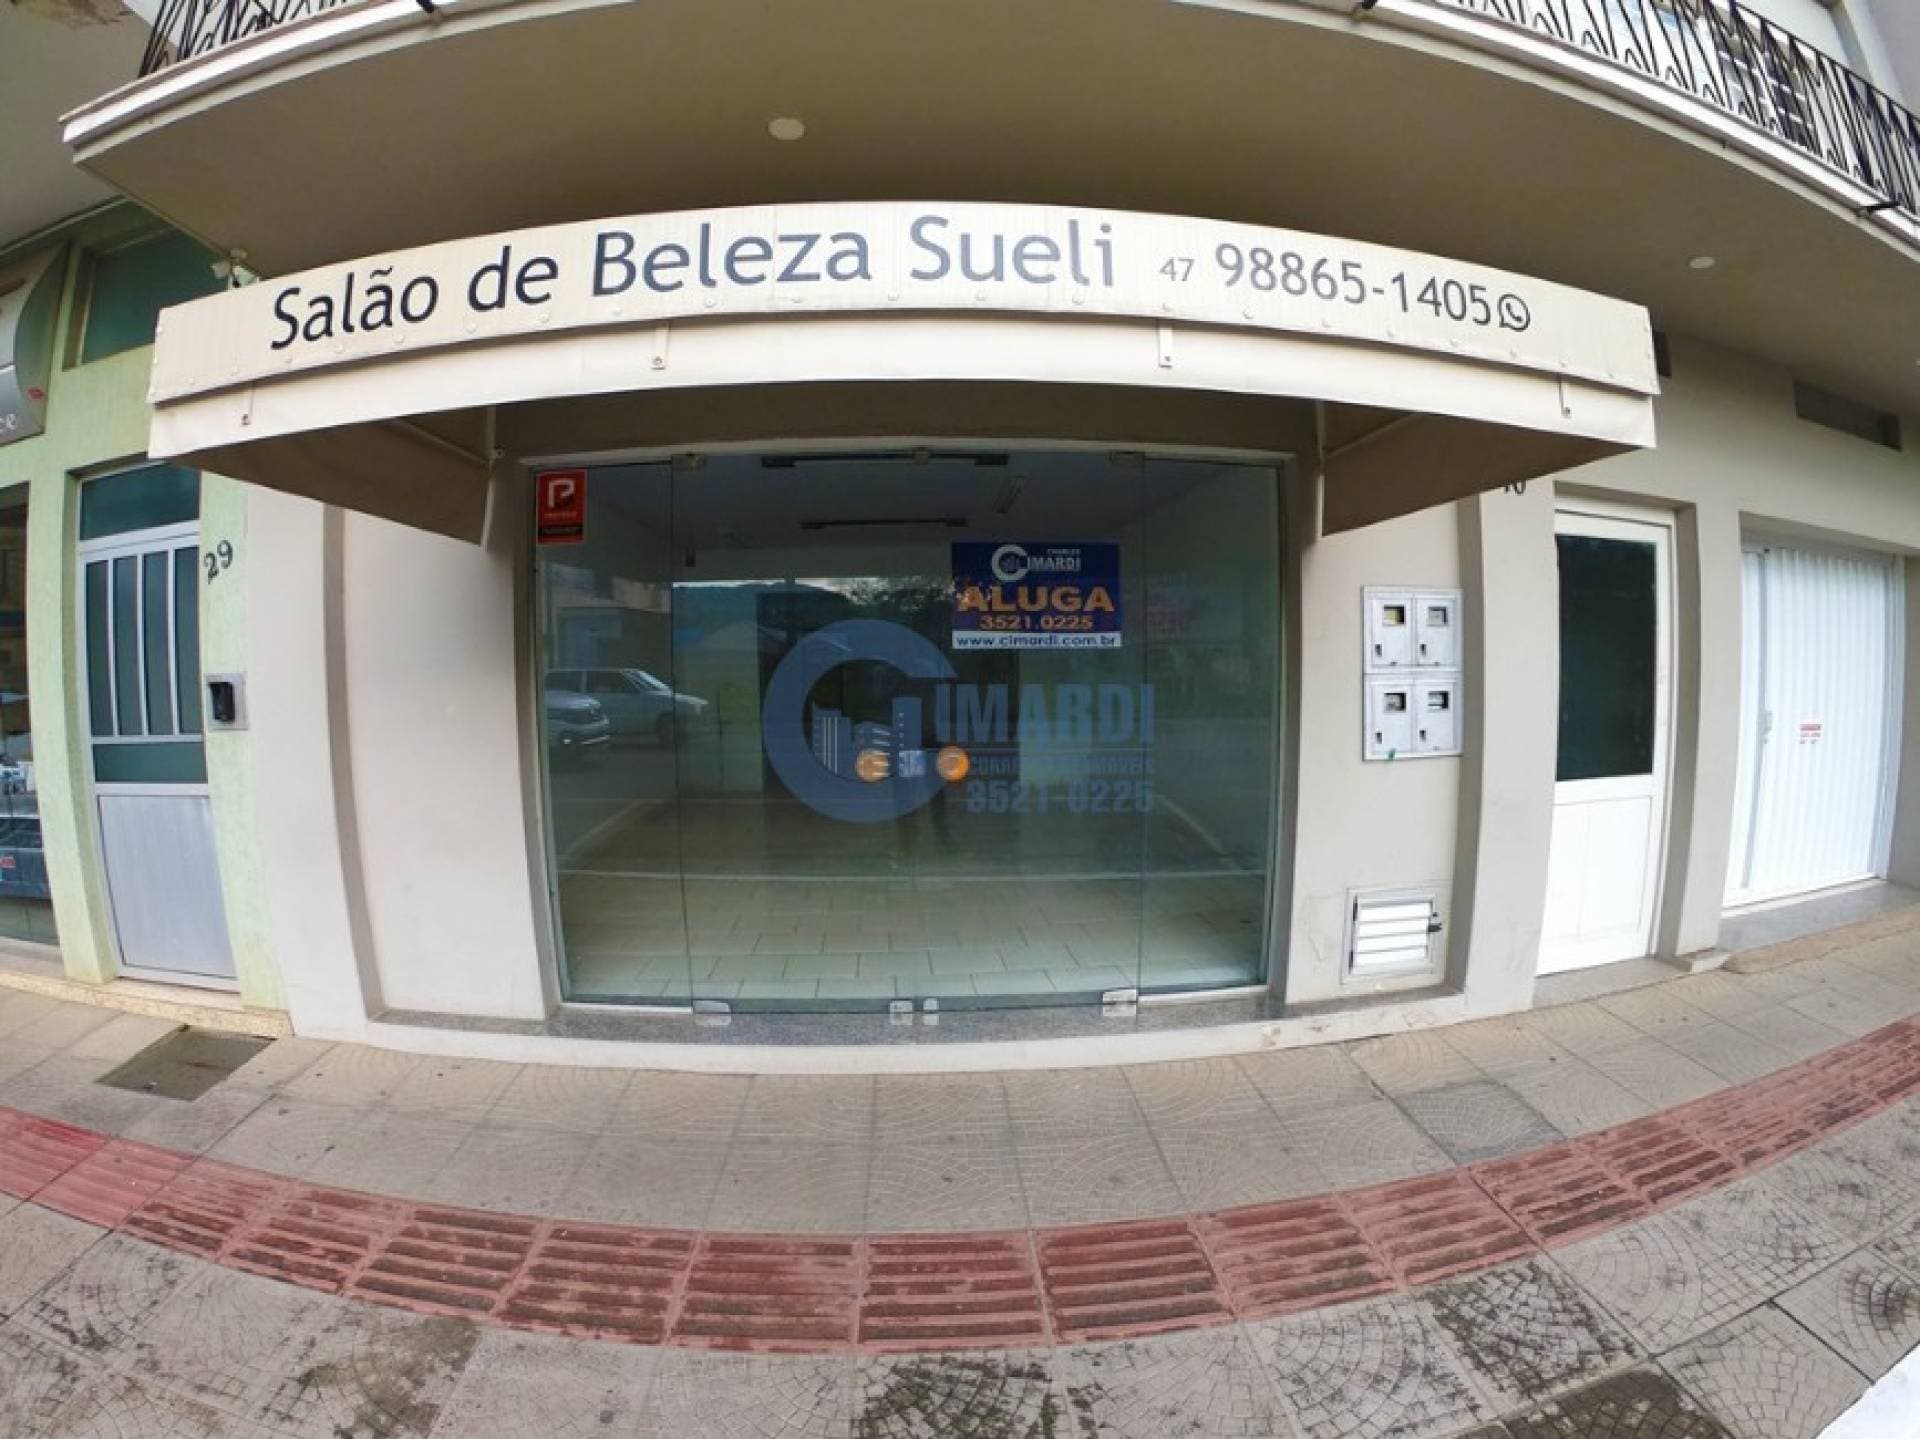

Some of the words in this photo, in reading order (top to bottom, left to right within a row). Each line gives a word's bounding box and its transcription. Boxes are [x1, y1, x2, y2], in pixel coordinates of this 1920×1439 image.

[271, 267, 439, 350] Salão
[468, 245, 559, 312] de
[592, 222, 872, 297] Beleza
[909, 214, 1114, 288] Sueli
[1159, 257, 1195, 282] 47
[1214, 242, 1492, 326] 98865-1405
[203, 539, 234, 585] 29
[957, 585, 1115, 612] ALUGA
[956, 634, 1115, 648] www.cimardi.com.br
